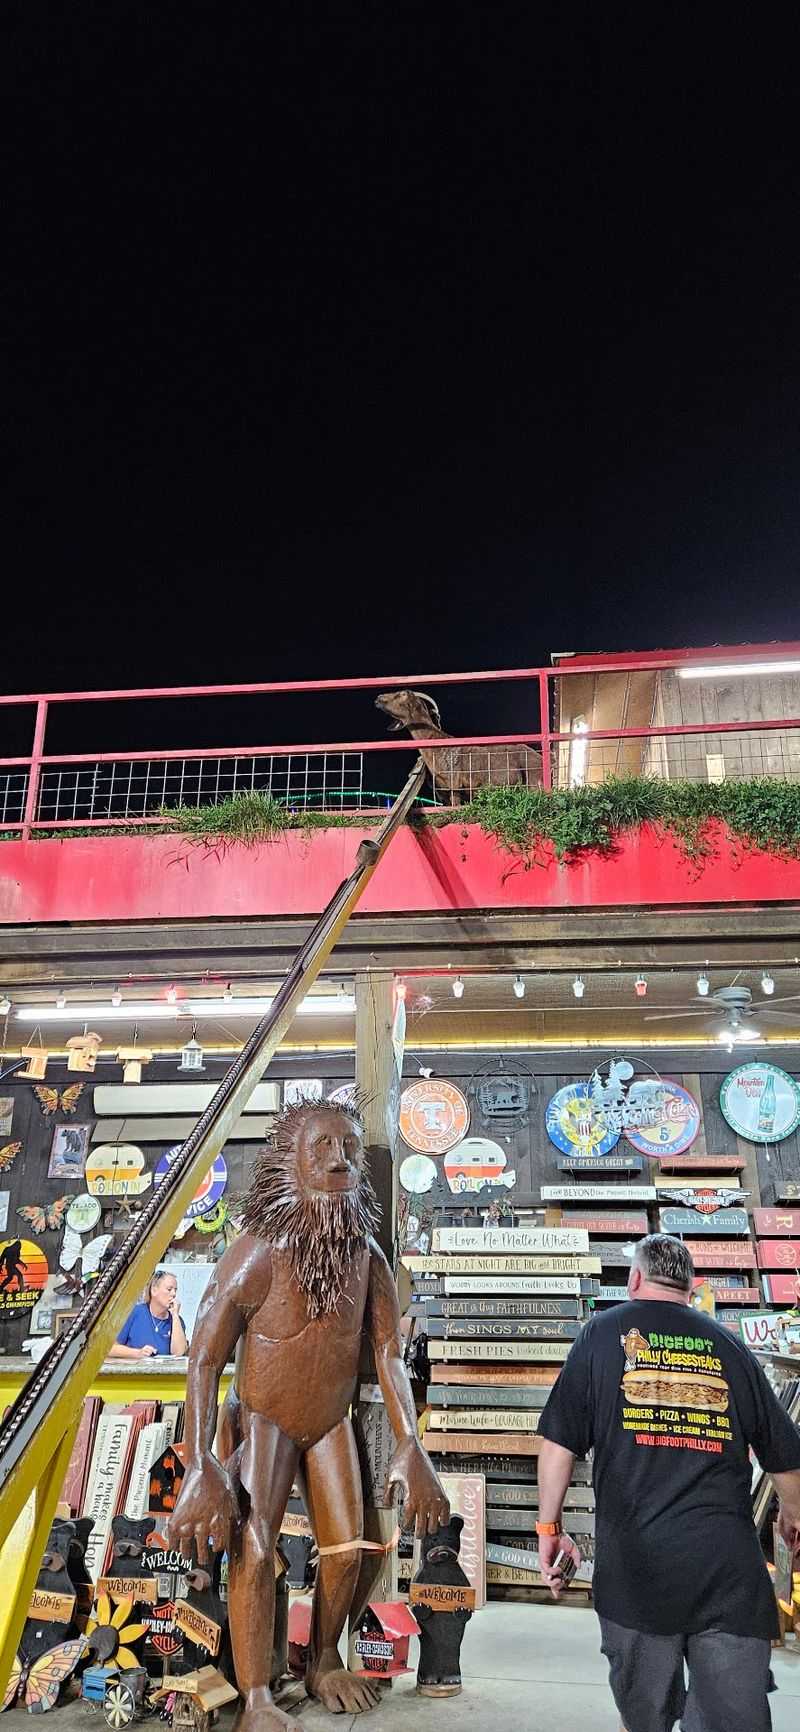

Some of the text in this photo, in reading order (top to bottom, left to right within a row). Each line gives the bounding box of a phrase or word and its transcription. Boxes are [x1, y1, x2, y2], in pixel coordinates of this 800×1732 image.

[563, 1187, 596, 1199] BEYOND
[187, 1195, 213, 1216] VICE
[663, 1214, 746, 1230] Cherish Family
[454, 1231, 478, 1247] Love
[483, 1231, 497, 1246] No
[502, 1231, 537, 1247] Matter
[542, 1231, 572, 1249] What
[435, 1258, 461, 1270] STARS
[464, 1258, 477, 1270] AT
[479, 1258, 501, 1270] NIGHT
[504, 1258, 522, 1271] ARE
[524, 1258, 538, 1271] BIG
[552, 1258, 582, 1271] BRIGHT
[15, 1291, 39, 1301] SEEK
[716, 1290, 753, 1300] ARKET
[441, 1302, 469, 1315] GREAT
[496, 1301, 562, 1316] FAITHFULNESS
[443, 1323, 565, 1337] then SINGS MY soul
[648, 1332, 713, 1353] BIGFOOT
[442, 1346, 482, 1357] FRESH
[486, 1346, 514, 1357] PIES
[637, 1349, 661, 1365] PHILLY
[661, 1350, 722, 1372] CHEESESTEAKS
[622, 1407, 730, 1429] BURGERS PIZZA WINGS BBQ
[673, 1425, 682, 1434] ICE
[682, 1426, 701, 1436] CREAM
[99, 1423, 129, 1477] Family
[636, 1434, 723, 1453] WWW.BIGFOOTPHILLY.COM
[99, 1482, 115, 1521] makes
[85, 1533, 106, 1569] HOM
[501, 1551, 521, 1564] GOD
[147, 1551, 193, 1571] WELCOM
[107, 1579, 148, 1595] WELCOME
[423, 1587, 468, 1603] WELCOME
[32, 1591, 62, 1610] LCOME
